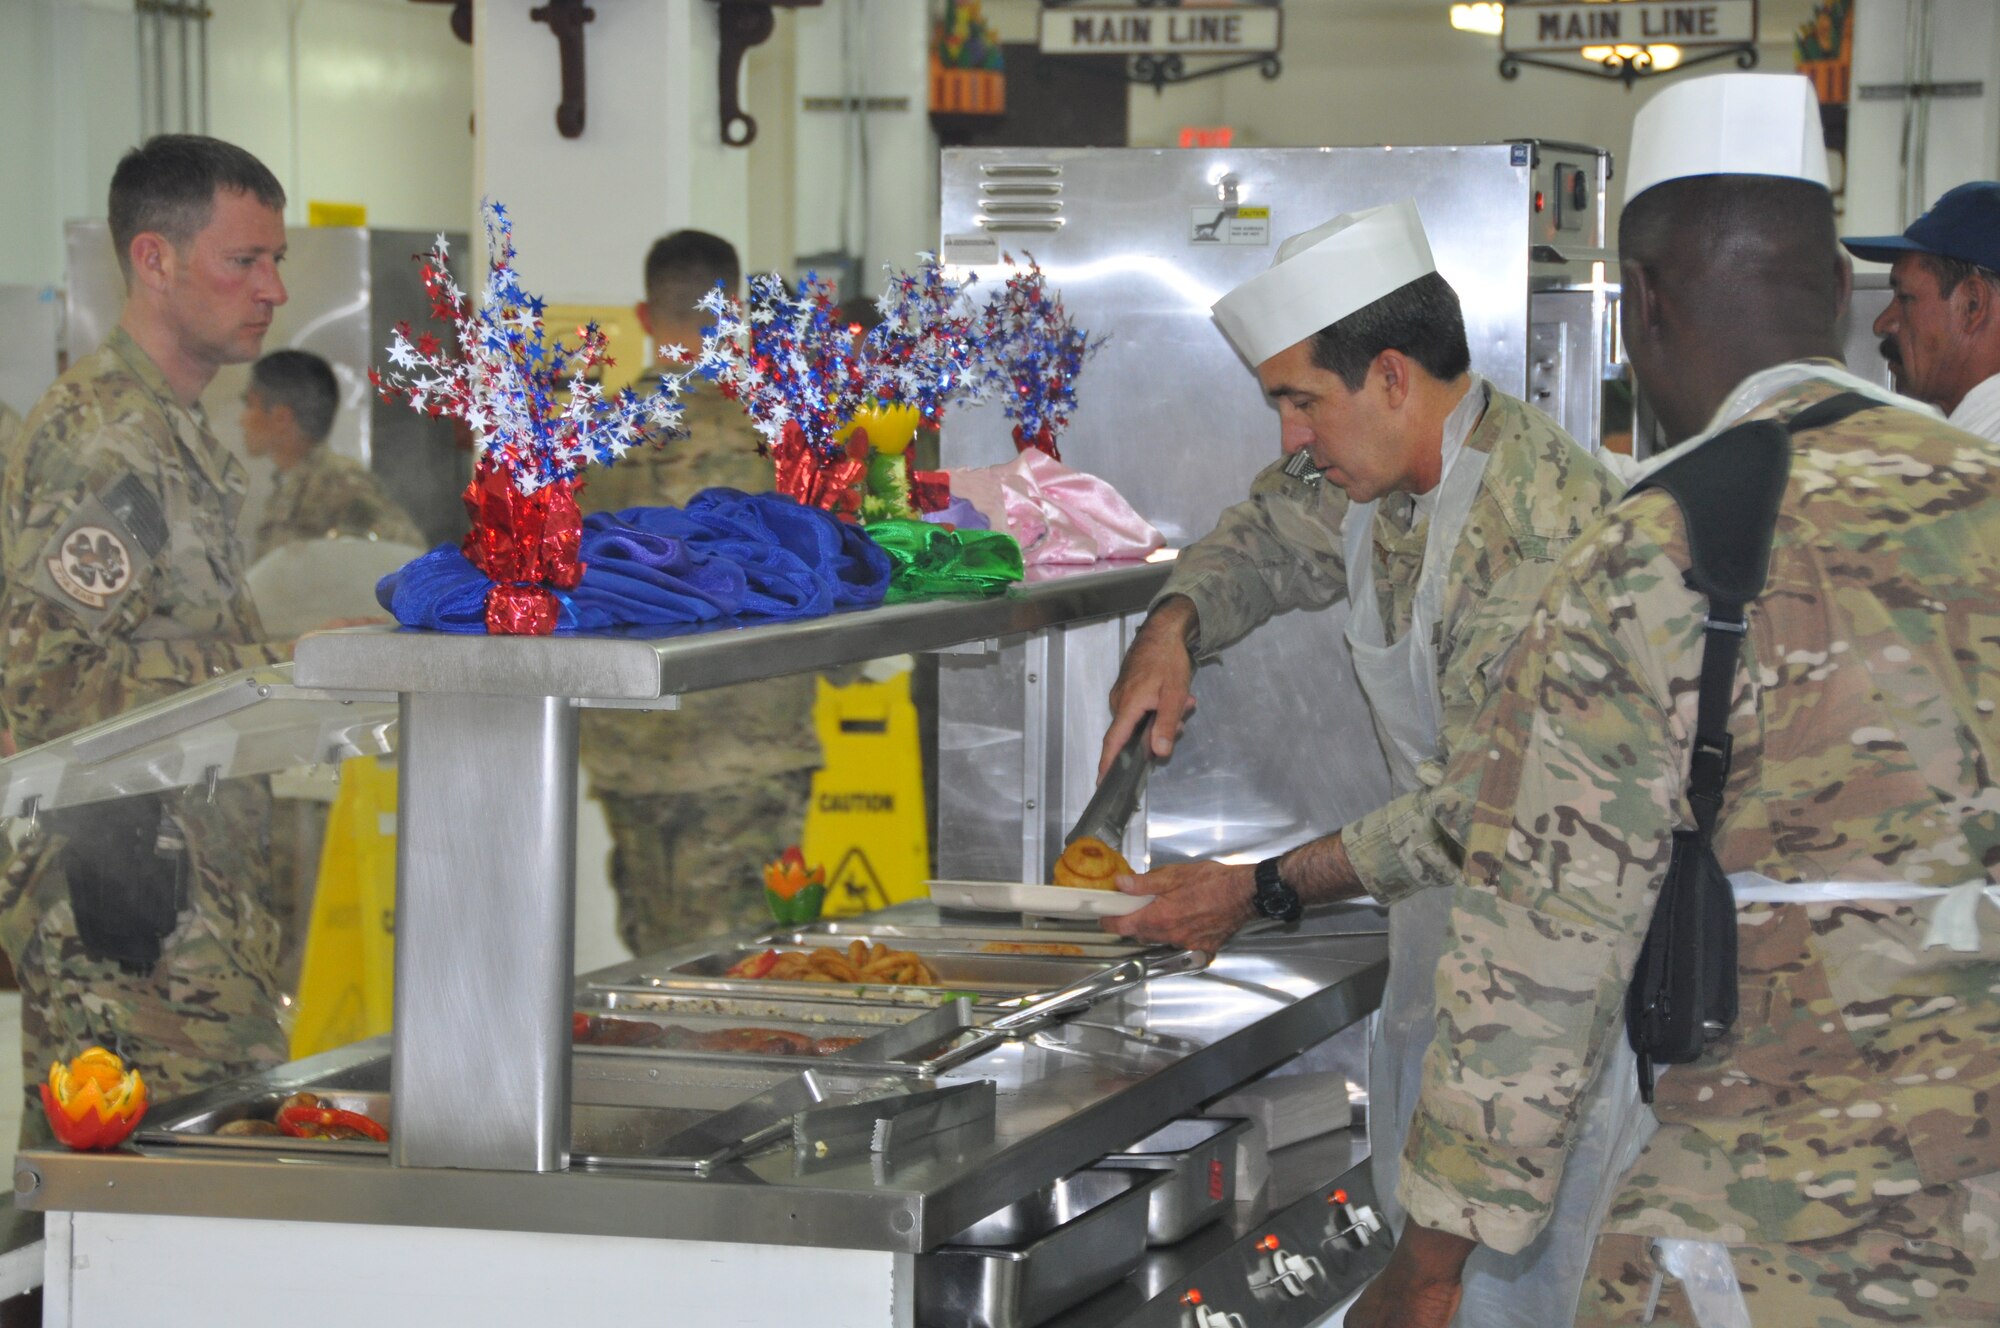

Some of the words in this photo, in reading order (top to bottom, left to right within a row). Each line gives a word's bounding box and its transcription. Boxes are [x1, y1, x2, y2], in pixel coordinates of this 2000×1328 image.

[1072, 17, 1150, 44] MAIN
[1168, 15, 1242, 43] LINE
[1538, 12, 1620, 40] MAIN
[1641, 7, 1717, 37] LINE
[820, 793, 895, 813] CAUTION
